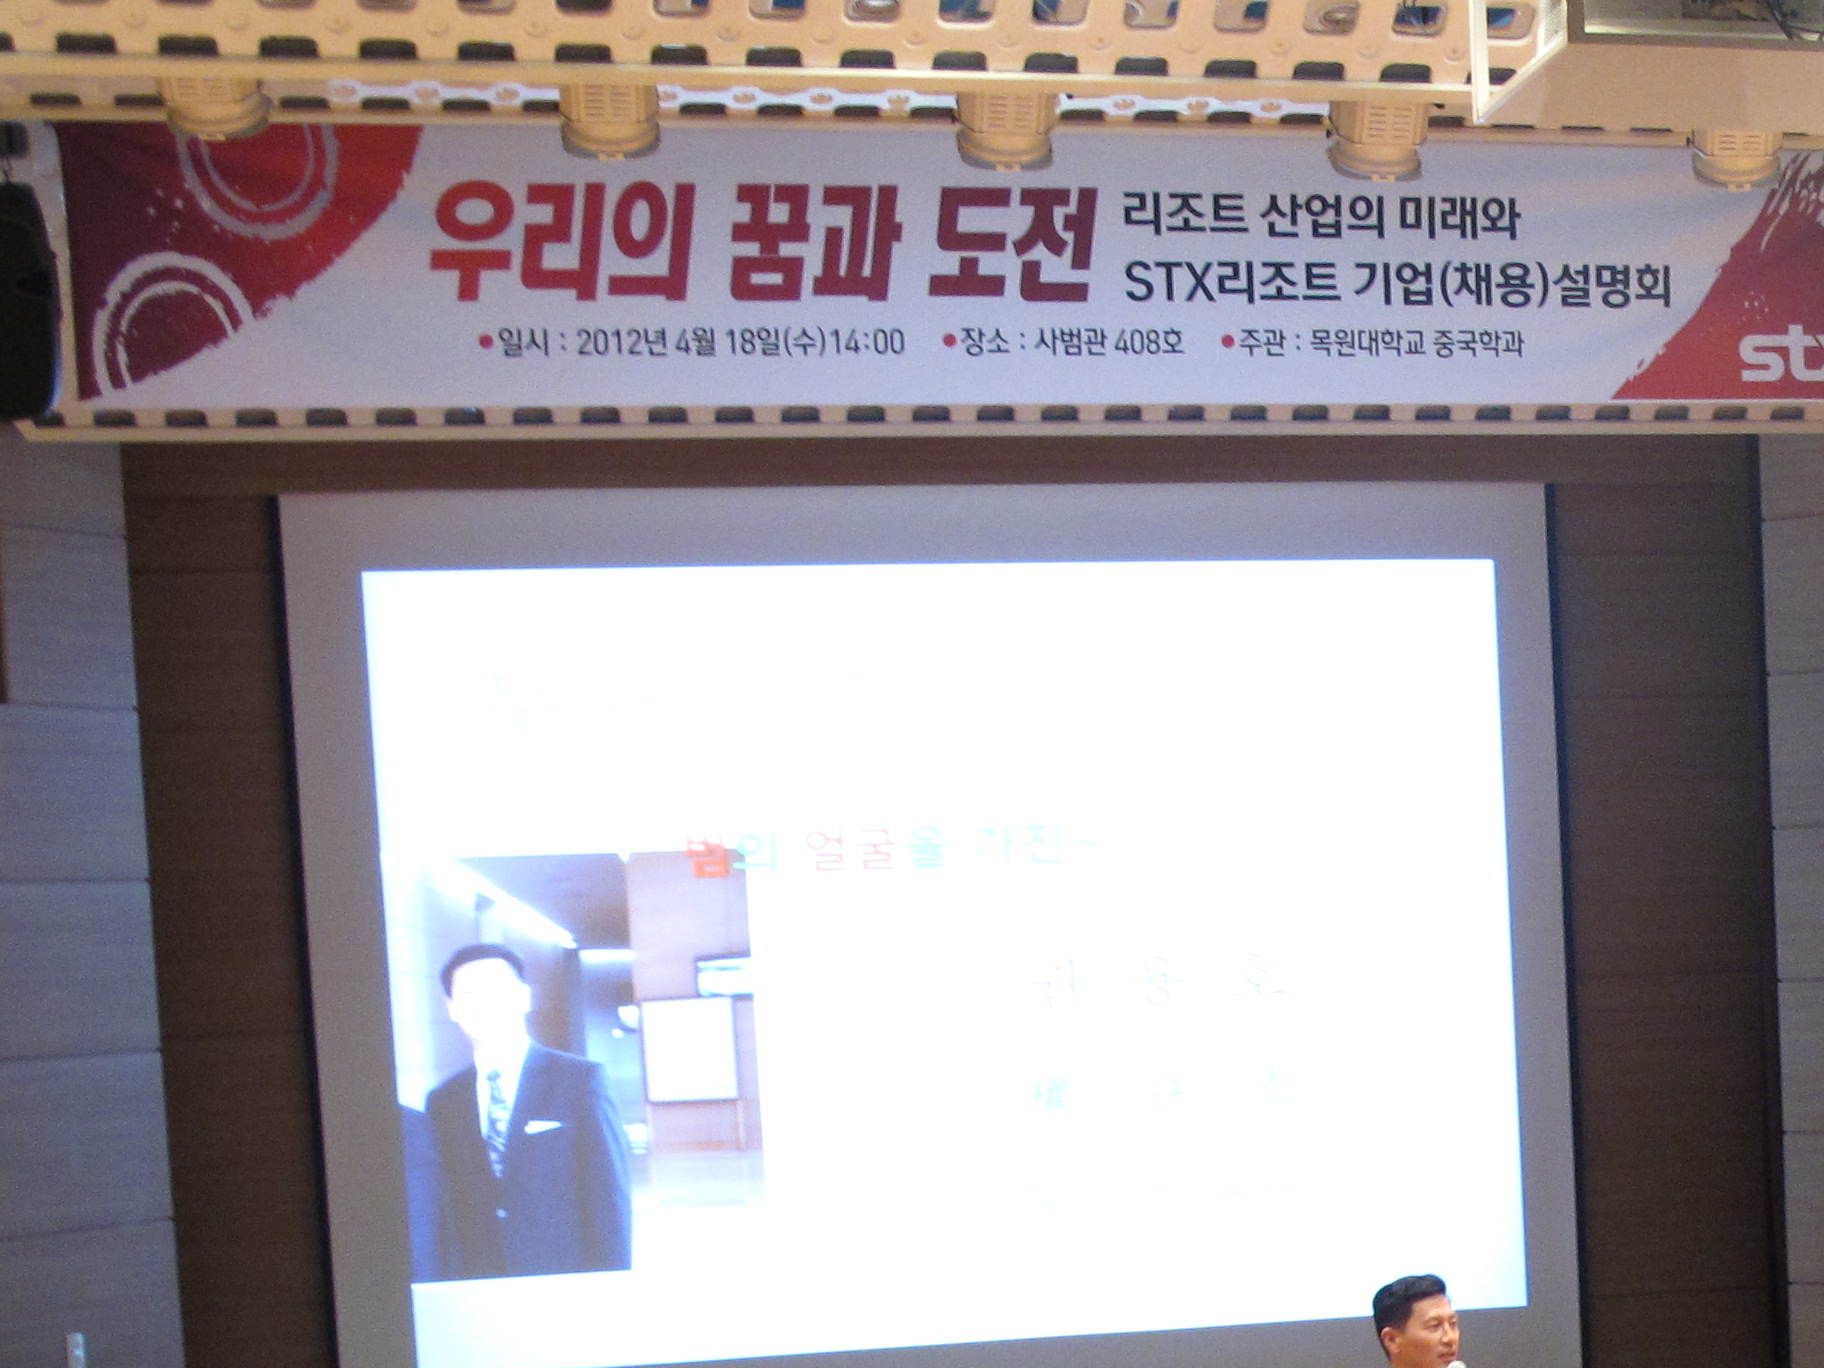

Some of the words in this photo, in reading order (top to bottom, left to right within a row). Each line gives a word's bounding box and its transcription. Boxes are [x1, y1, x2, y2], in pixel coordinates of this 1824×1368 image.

[1122, 191, 1249, 236] 리조트
[1259, 193, 1386, 240] 산업의
[1399, 196, 1522, 241] 미래와
[430, 179, 696, 302] 우리의
[730, 183, 903, 302] 꿈과
[928, 186, 1099, 303] 도전
[1124, 260, 1342, 305] STX리조트
[1354, 260, 1672, 309] 기업(채용)설명회
[576, 327, 668, 357] 2012년
[674, 327, 716, 357] 4월
[1034, 327, 1108, 357] 사범관
[1114, 327, 1185, 356] 408호
[1310, 328, 1427, 358] 목원대학교
[1433, 329, 1525, 359] 중국학과
